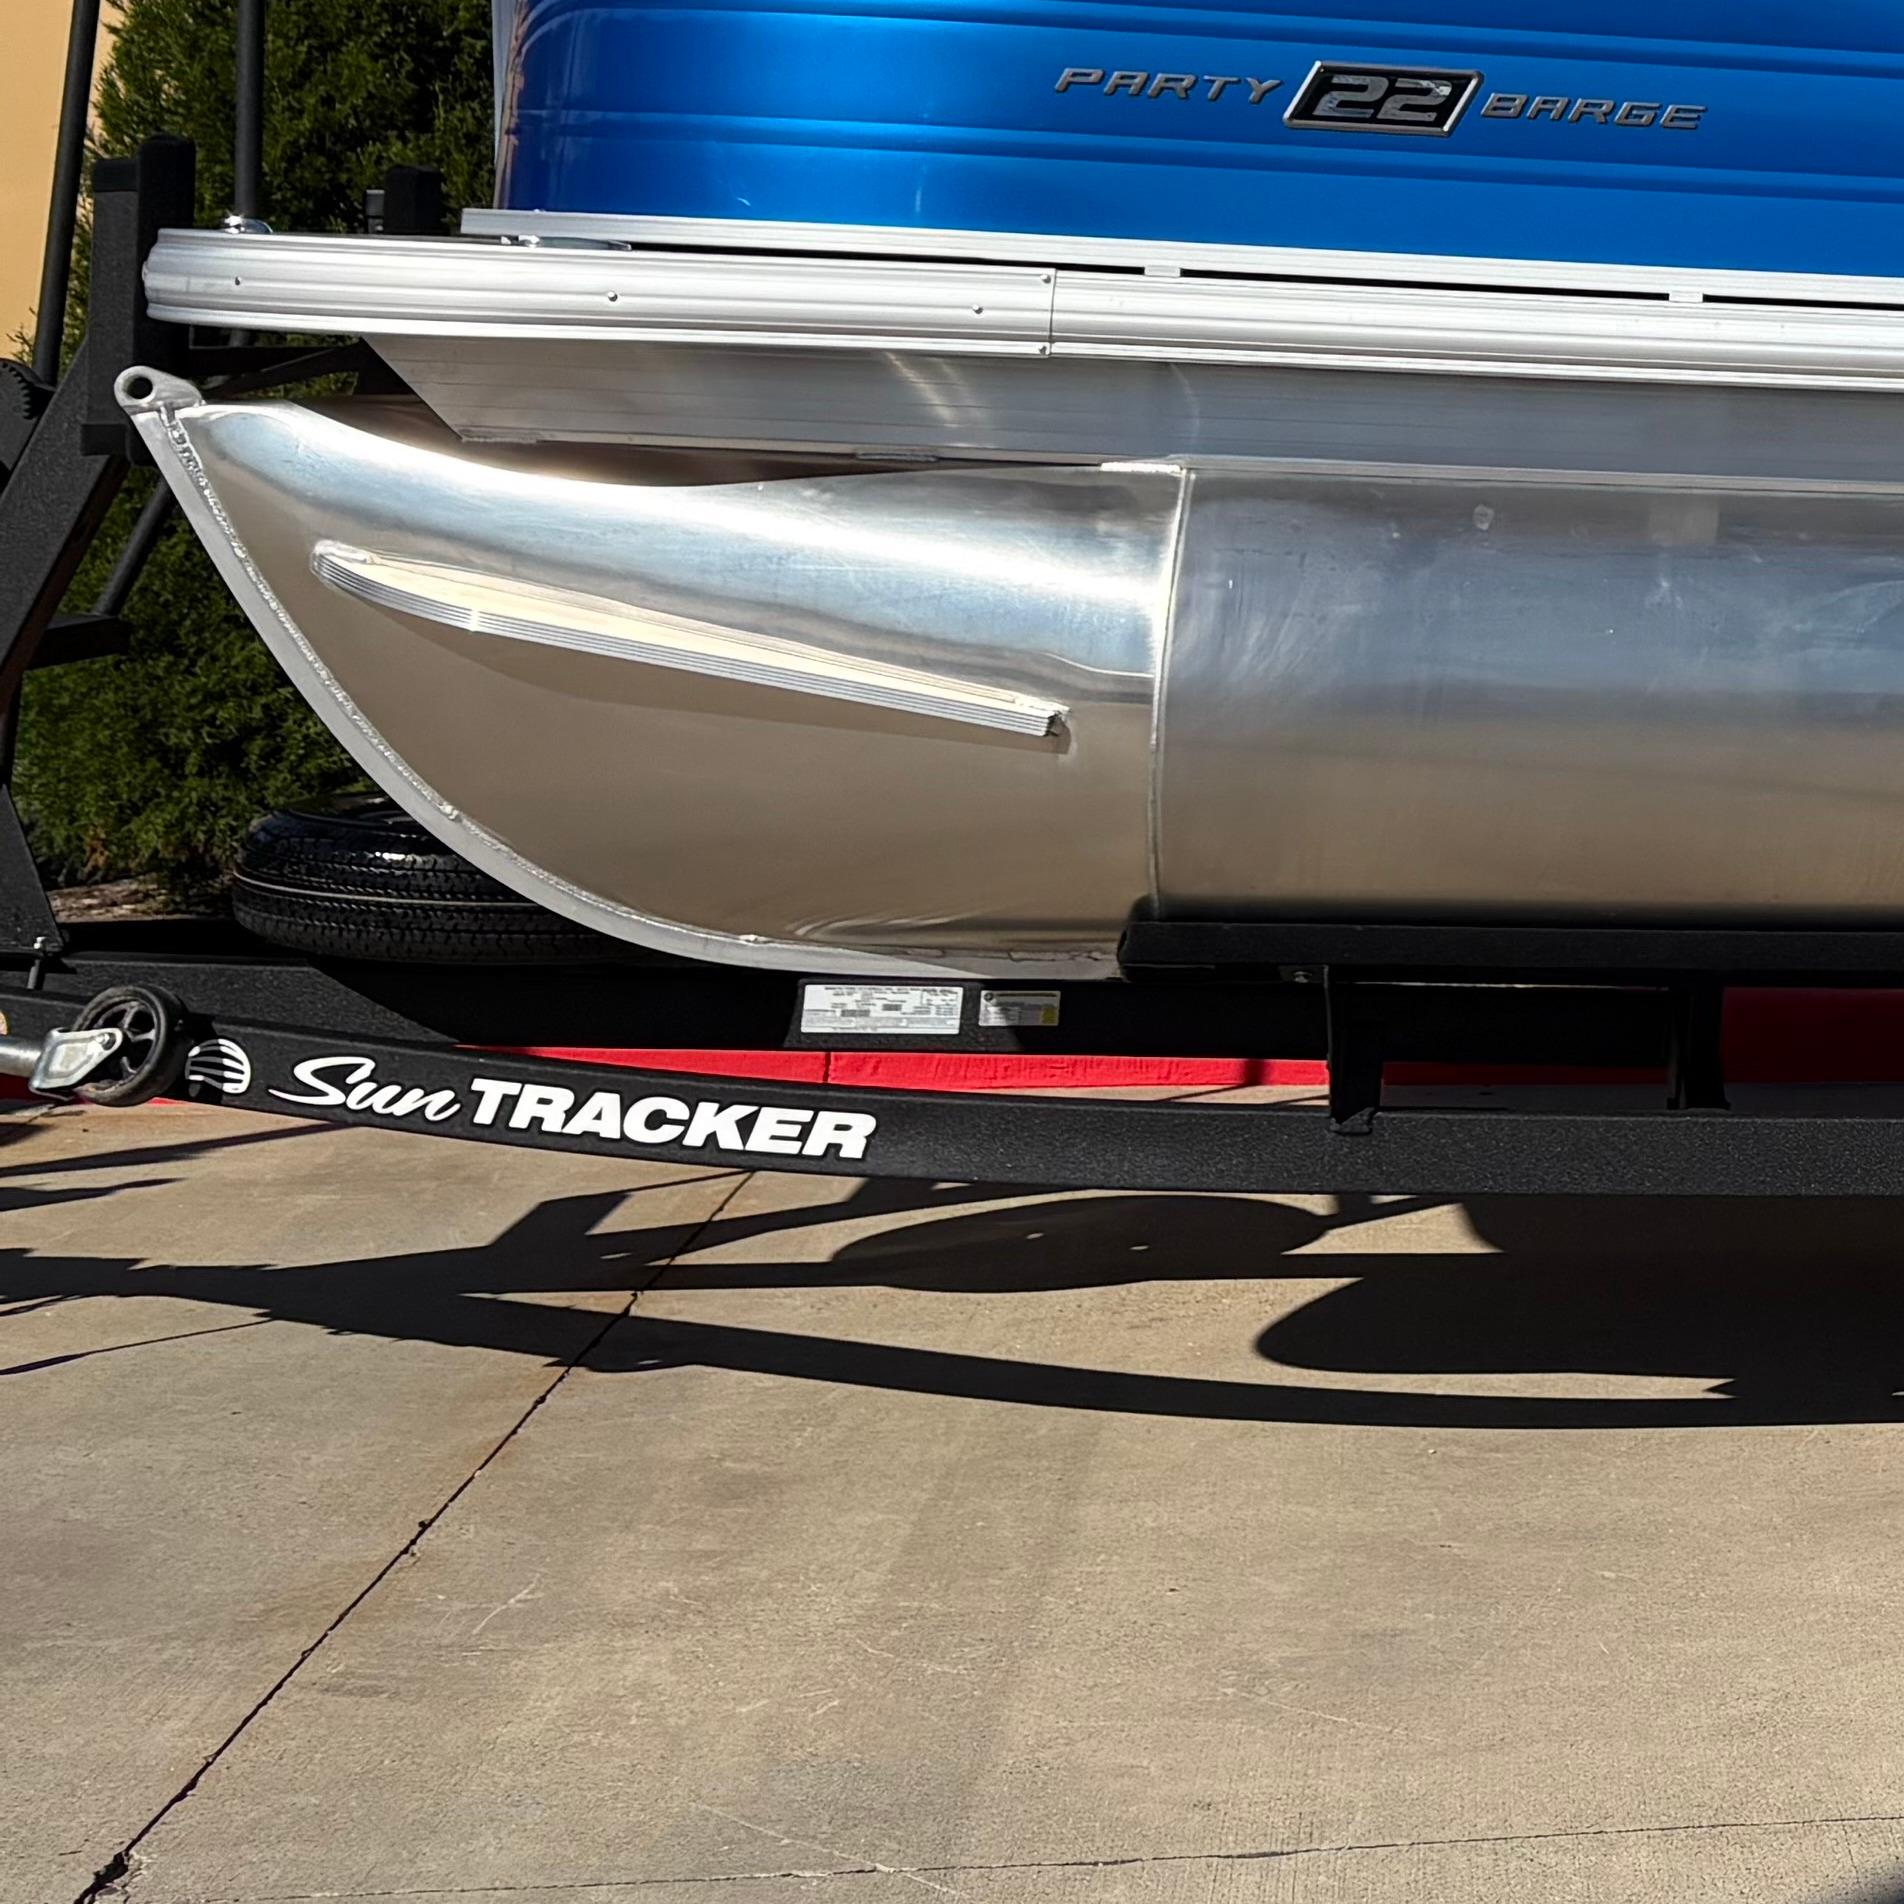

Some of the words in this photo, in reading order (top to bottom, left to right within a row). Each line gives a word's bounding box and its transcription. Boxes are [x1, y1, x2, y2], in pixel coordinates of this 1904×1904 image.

[1054, 66, 1280, 105] PARTY
[1312, 74, 1454, 122] 22
[1480, 92, 1708, 130] BARGE
[269, 1054, 463, 1125] Sun
[468, 1076, 879, 1162] TRACKER
